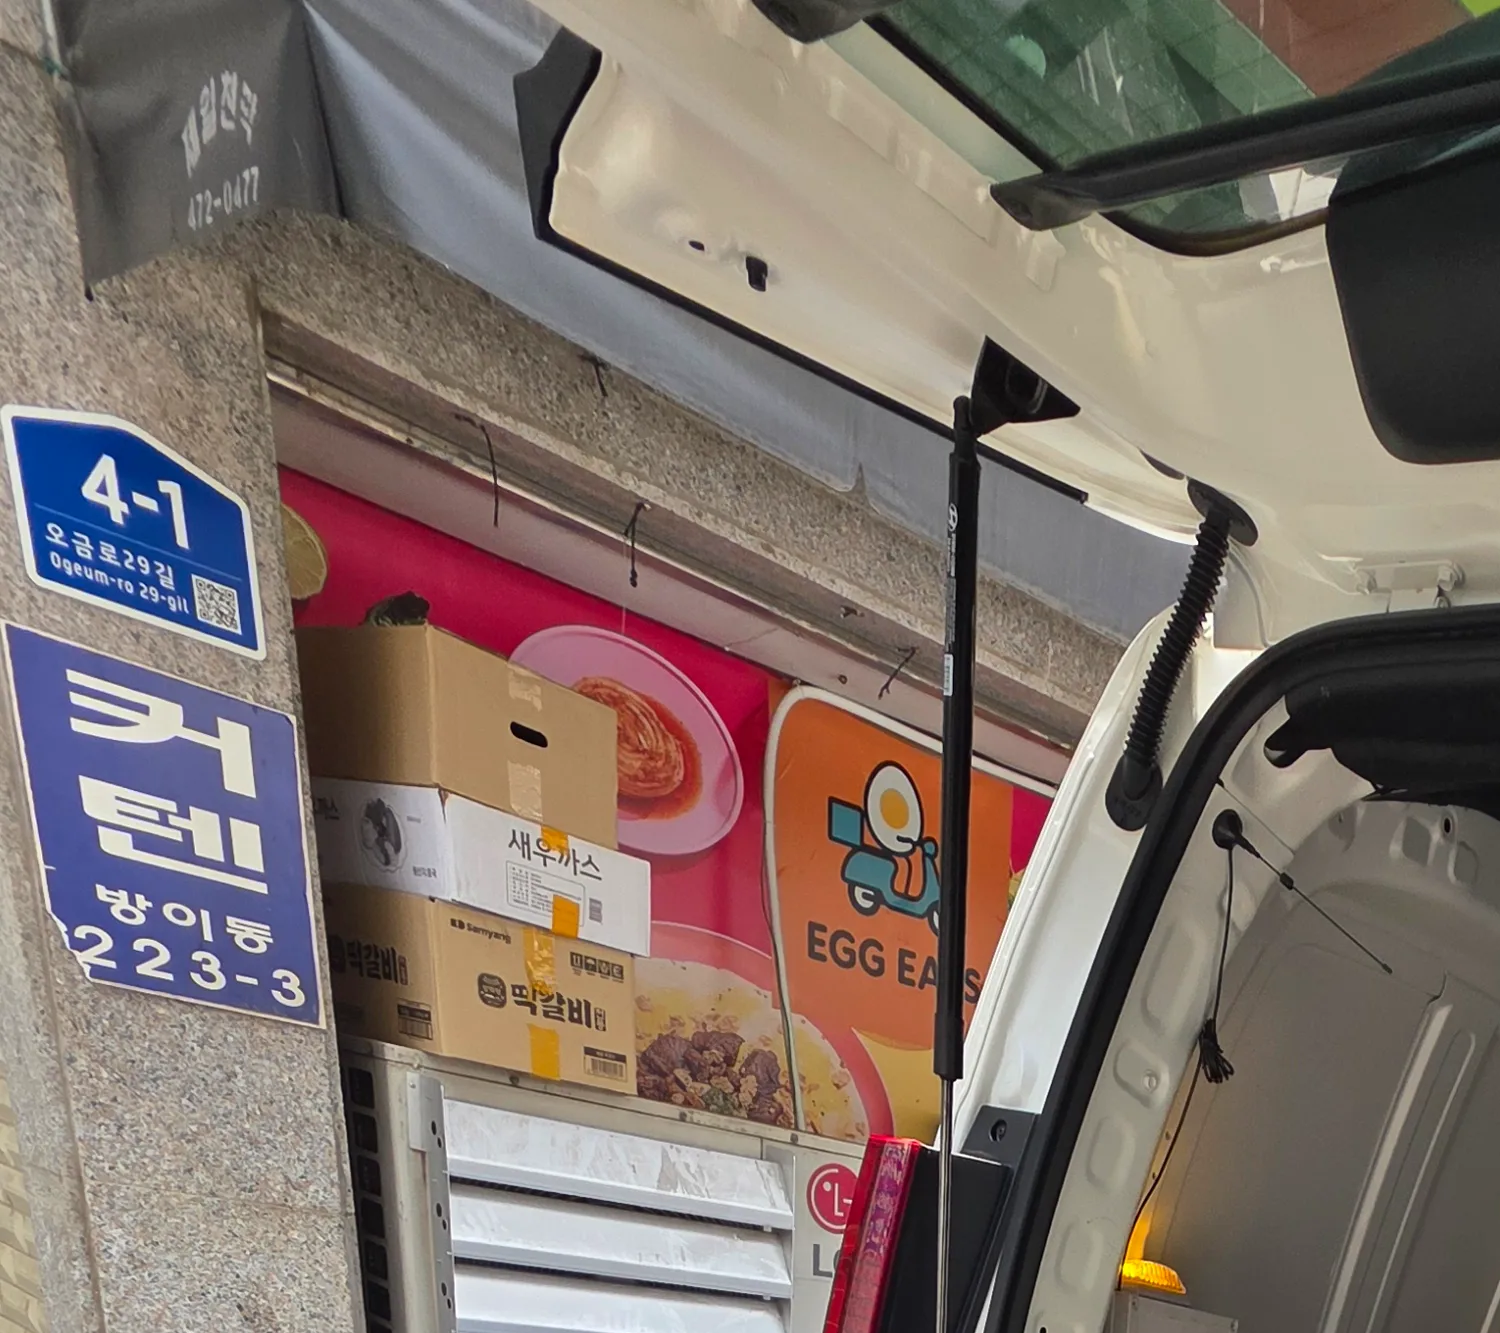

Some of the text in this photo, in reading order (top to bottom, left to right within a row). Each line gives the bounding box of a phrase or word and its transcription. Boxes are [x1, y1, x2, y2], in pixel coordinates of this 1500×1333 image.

[81, 453, 190, 550] 4-1
[45, 522, 176, 591] 오금로29길
[49, 550, 190, 615] Ogeum-ro 29-gil
[65, 668, 269, 895] 커텐
[507, 828, 603, 881] 새우까스
[95, 882, 275, 955] 방이동
[466, 922, 512, 944] Samyang
[72, 924, 307, 1009] 223-3
[806, 921, 982, 1004] EGG EAS
[509, 981, 593, 1029] 떡갈비
